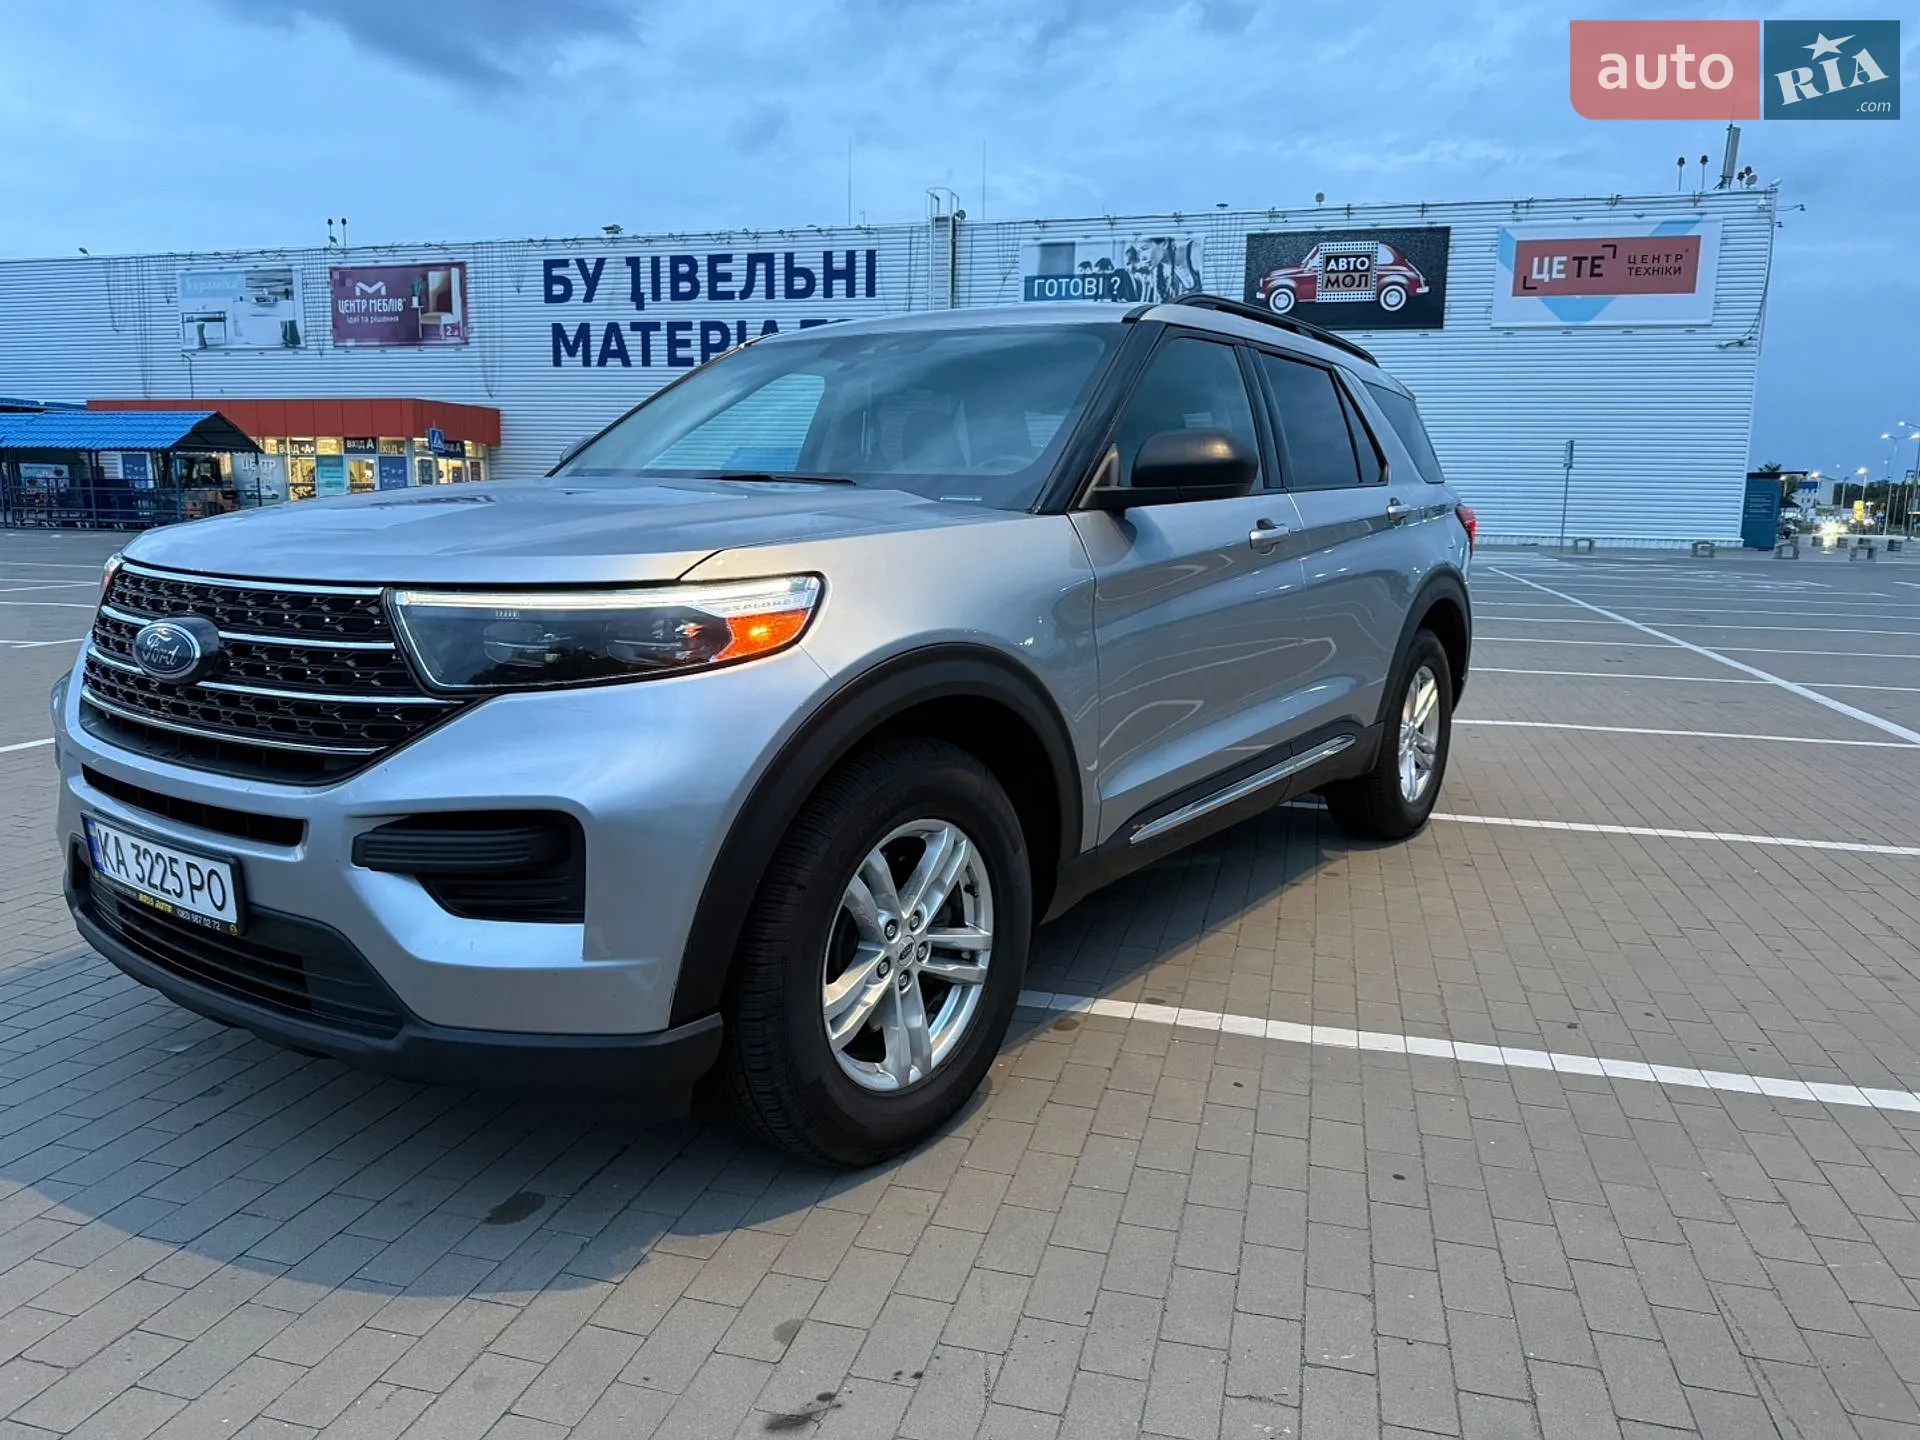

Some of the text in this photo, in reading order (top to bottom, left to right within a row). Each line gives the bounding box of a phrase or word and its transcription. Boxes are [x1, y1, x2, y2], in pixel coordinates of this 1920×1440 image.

[1326, 257, 1370, 271] АВТО
[1627, 253, 1684, 265] ЦЕНТР
[1627, 266, 1682, 277] ТЕХНІКИ
[1034, 277, 1103, 297] ГОТОВІ
[1324, 274, 1369, 288] МОЛ
[338, 299, 368, 314] ЦЕНТР
[551, 319, 854, 368] МАТЕРІ
